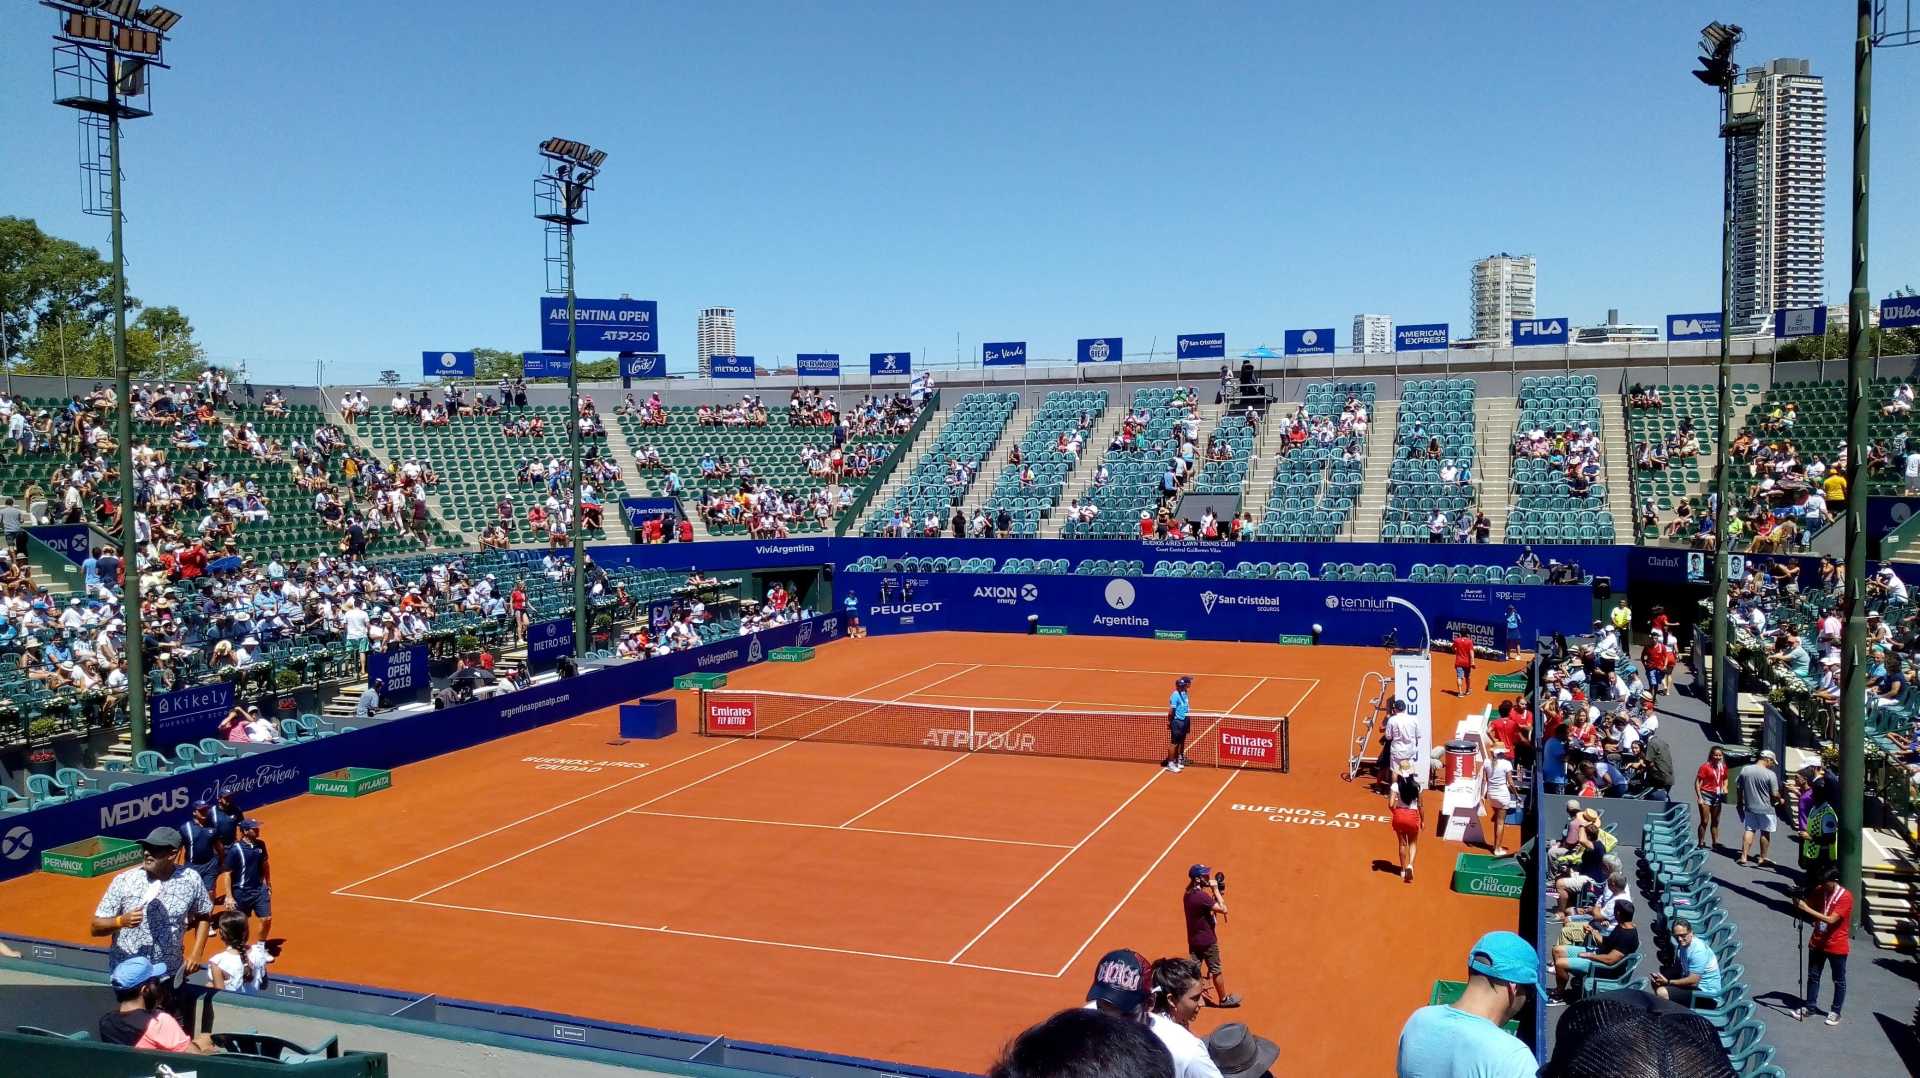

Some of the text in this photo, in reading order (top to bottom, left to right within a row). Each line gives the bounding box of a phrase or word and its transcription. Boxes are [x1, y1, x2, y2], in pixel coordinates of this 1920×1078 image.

[550, 308, 650, 322] ARENTINA OPEN
[1398, 329, 1446, 339] AMERICAN
[1519, 321, 1562, 336] FILA
[1405, 336, 1447, 345] EXPRESS
[985, 345, 1024, 362] Bio Verde
[1296, 346, 1325, 354] Argentina
[434, 367, 464, 376] Argentina
[714, 365, 739, 373] METRO
[974, 586, 1018, 600] AXION
[996, 597, 1017, 607] energy
[1218, 594, 1280, 607] San Cristóbal
[870, 602, 943, 616] PEUGEOT
[1093, 614, 1150, 627] Argentina
[533, 637, 558, 651] METRO
[388, 650, 412, 664] #ARG
[771, 652, 799, 661] Caladryl
[387, 663, 412, 678] OPEN
[387, 675, 412, 691] 2019
[1493, 682, 1527, 690] PERVINO
[170, 690, 228, 711] Kikely
[500, 694, 570, 718] argentinaopenatp.com
[711, 706, 752, 718] Emirates
[717, 716, 746, 725] FLY BETTER
[974, 731, 1036, 752] TOUR
[1221, 733, 1273, 748] Emirates
[1229, 746, 1266, 758] FLY BETTER
[521, 756, 650, 769] BUENOS AIRES
[535, 764, 604, 773] CIUDAD
[315, 784, 348, 793] MYLANTA
[100, 786, 190, 830] MEDICUS
[1230, 803, 1392, 824] BUENOS AIRE
[1266, 815, 1361, 829] CIUDAD
[44, 856, 84, 871] PERVINOX
[93, 849, 143, 871] PERVINOX
